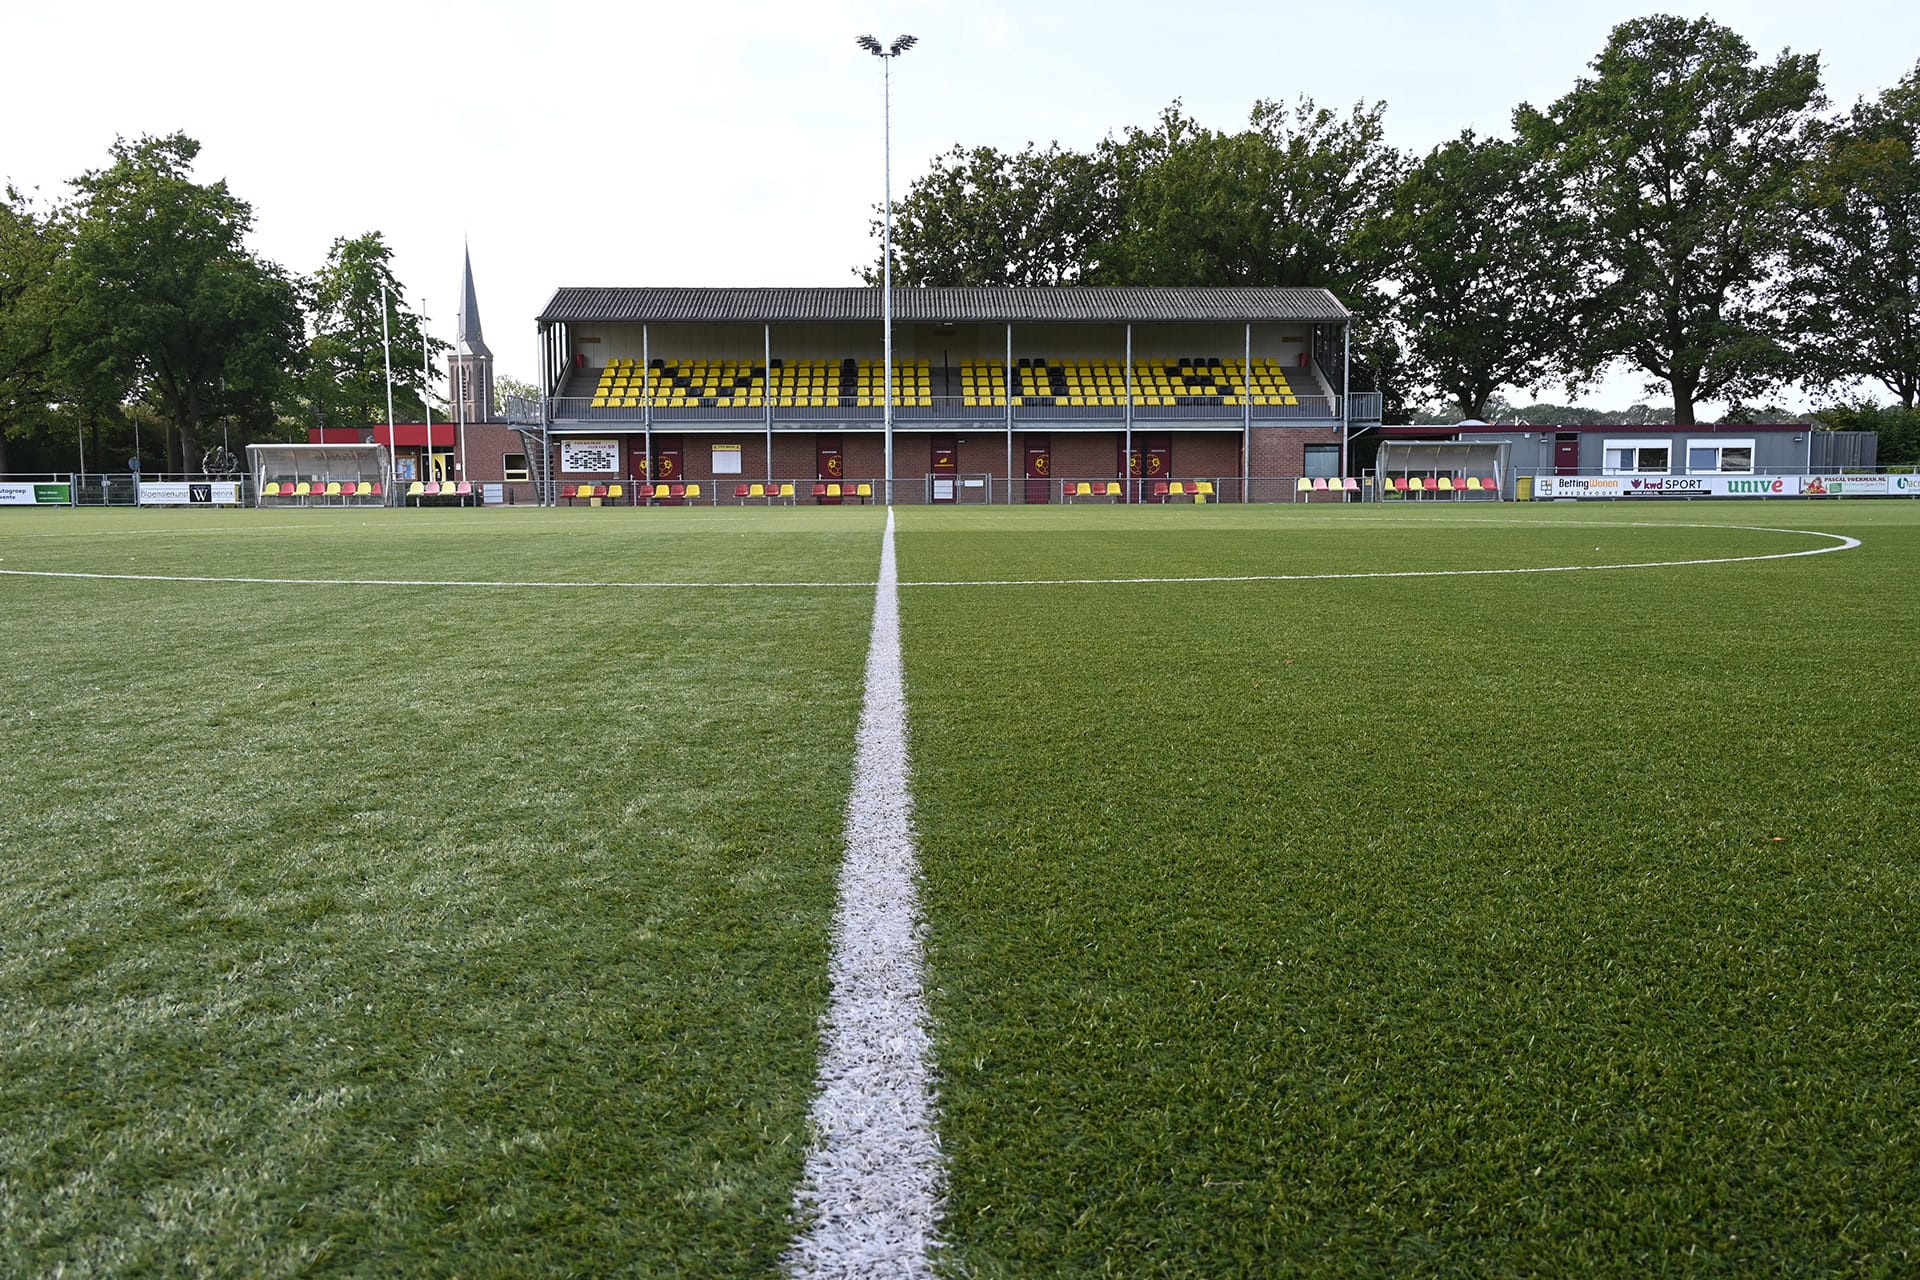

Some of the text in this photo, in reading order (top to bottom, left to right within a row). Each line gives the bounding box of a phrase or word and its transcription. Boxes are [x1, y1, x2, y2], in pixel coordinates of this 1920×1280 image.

[1559, 479, 1618, 490] BettingWonen
[1644, 478, 1703, 489] kwd SPORT
[1727, 476, 1784, 493] univé
